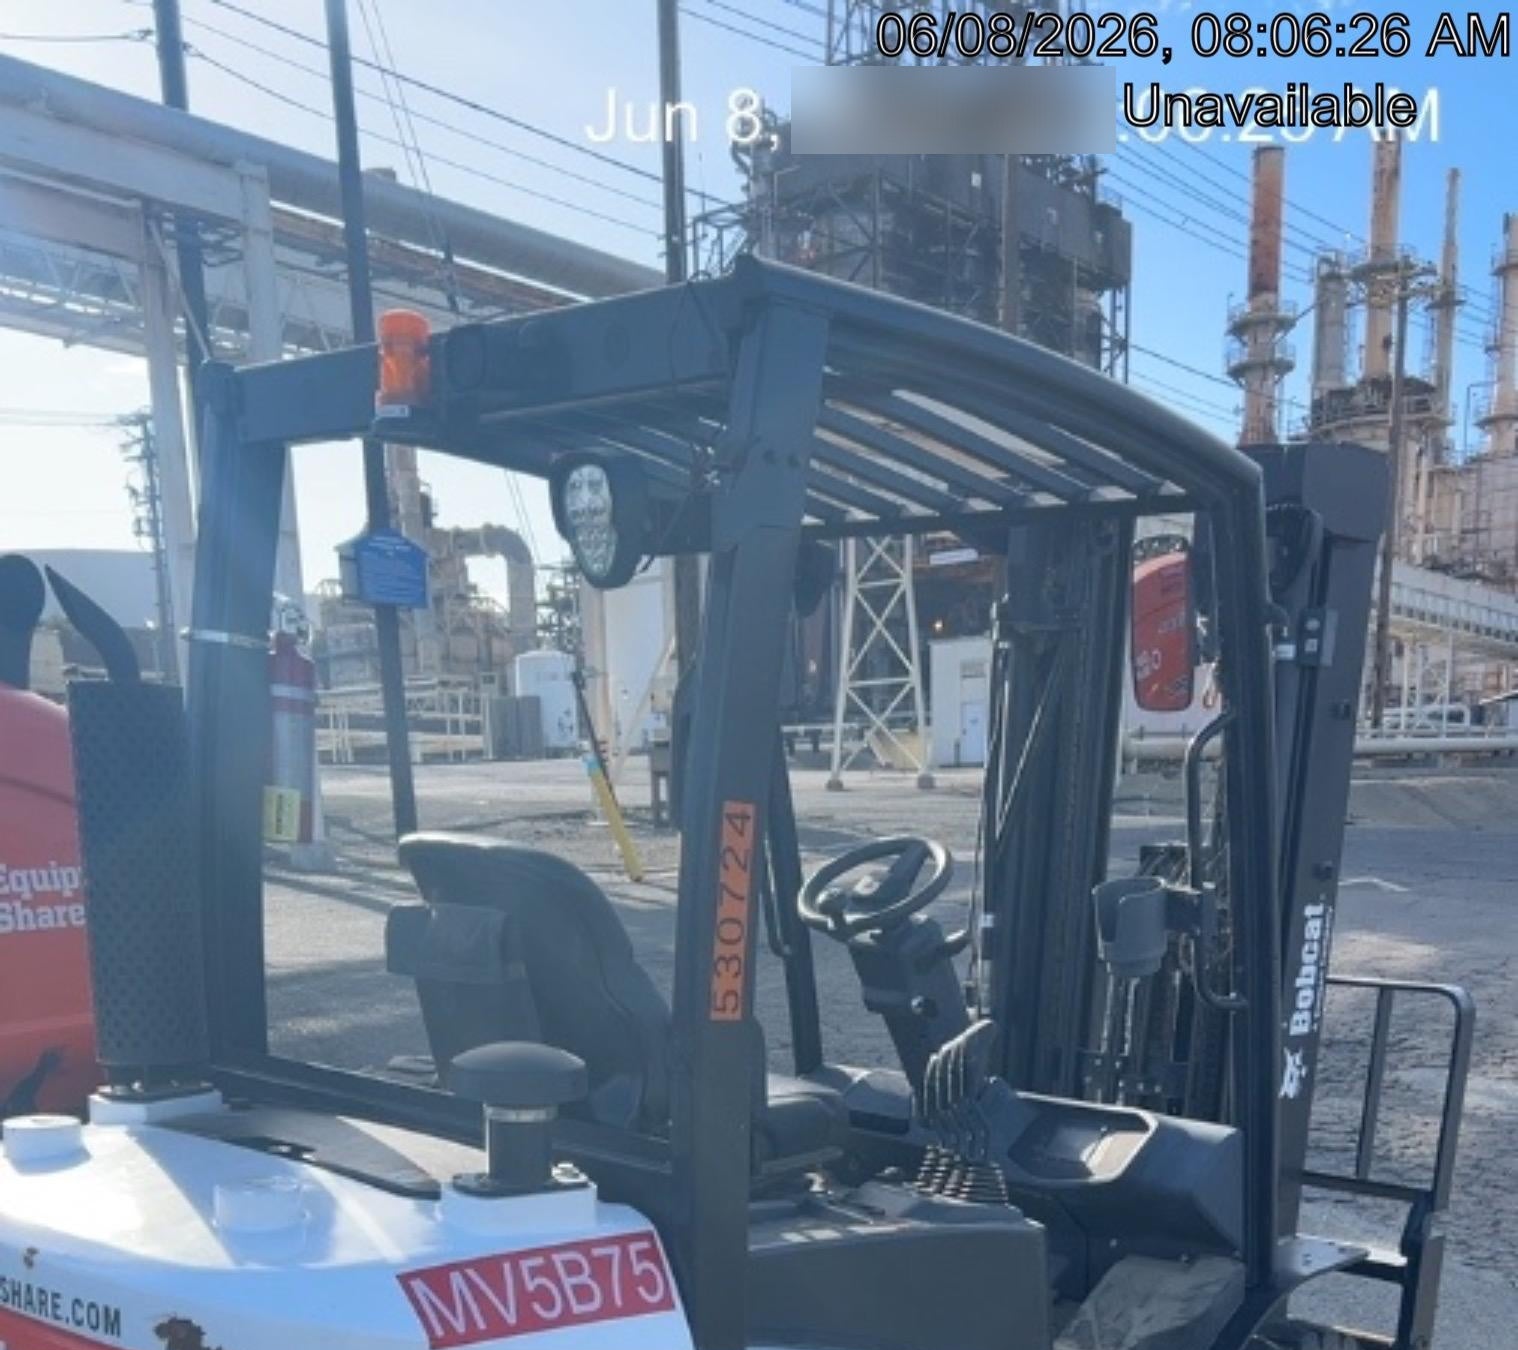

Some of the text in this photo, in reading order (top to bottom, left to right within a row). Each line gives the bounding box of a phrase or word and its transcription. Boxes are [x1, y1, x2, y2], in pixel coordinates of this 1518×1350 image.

[0, 900, 86, 932] Share
[714, 812, 751, 1014] 530724
[1289, 902, 1325, 1036] Bobcat
[408, 1241, 665, 1338] MV5B75
